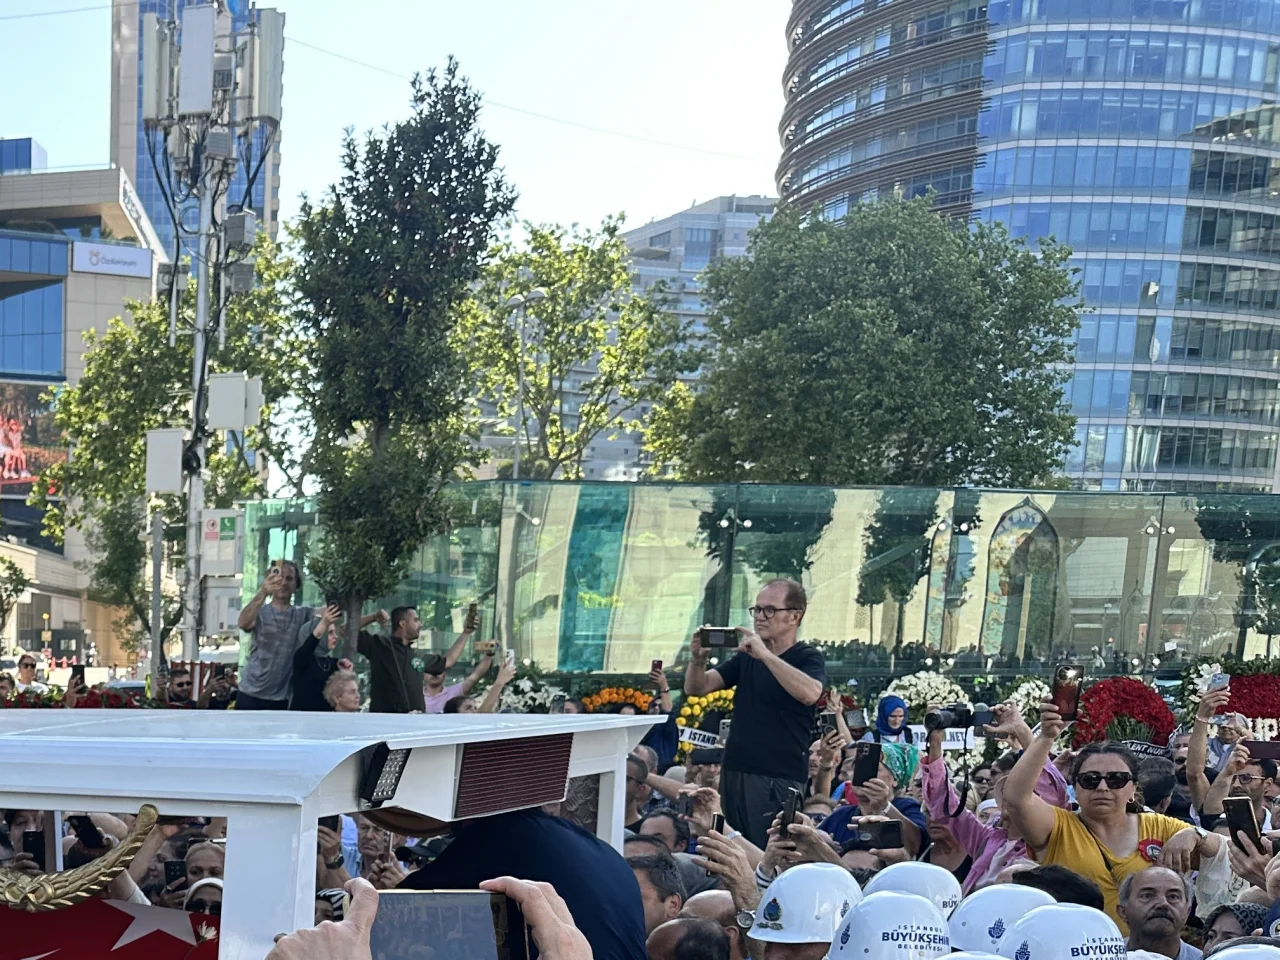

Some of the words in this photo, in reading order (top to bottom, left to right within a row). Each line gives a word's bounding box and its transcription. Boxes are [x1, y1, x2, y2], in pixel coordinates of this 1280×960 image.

[689, 730, 718, 746] İSTANB
[898, 924, 943, 933] İSTANBUL
[881, 929, 950, 947] BÜYÜKŞEHİR
[897, 943, 943, 952] BELEDİYESİ
